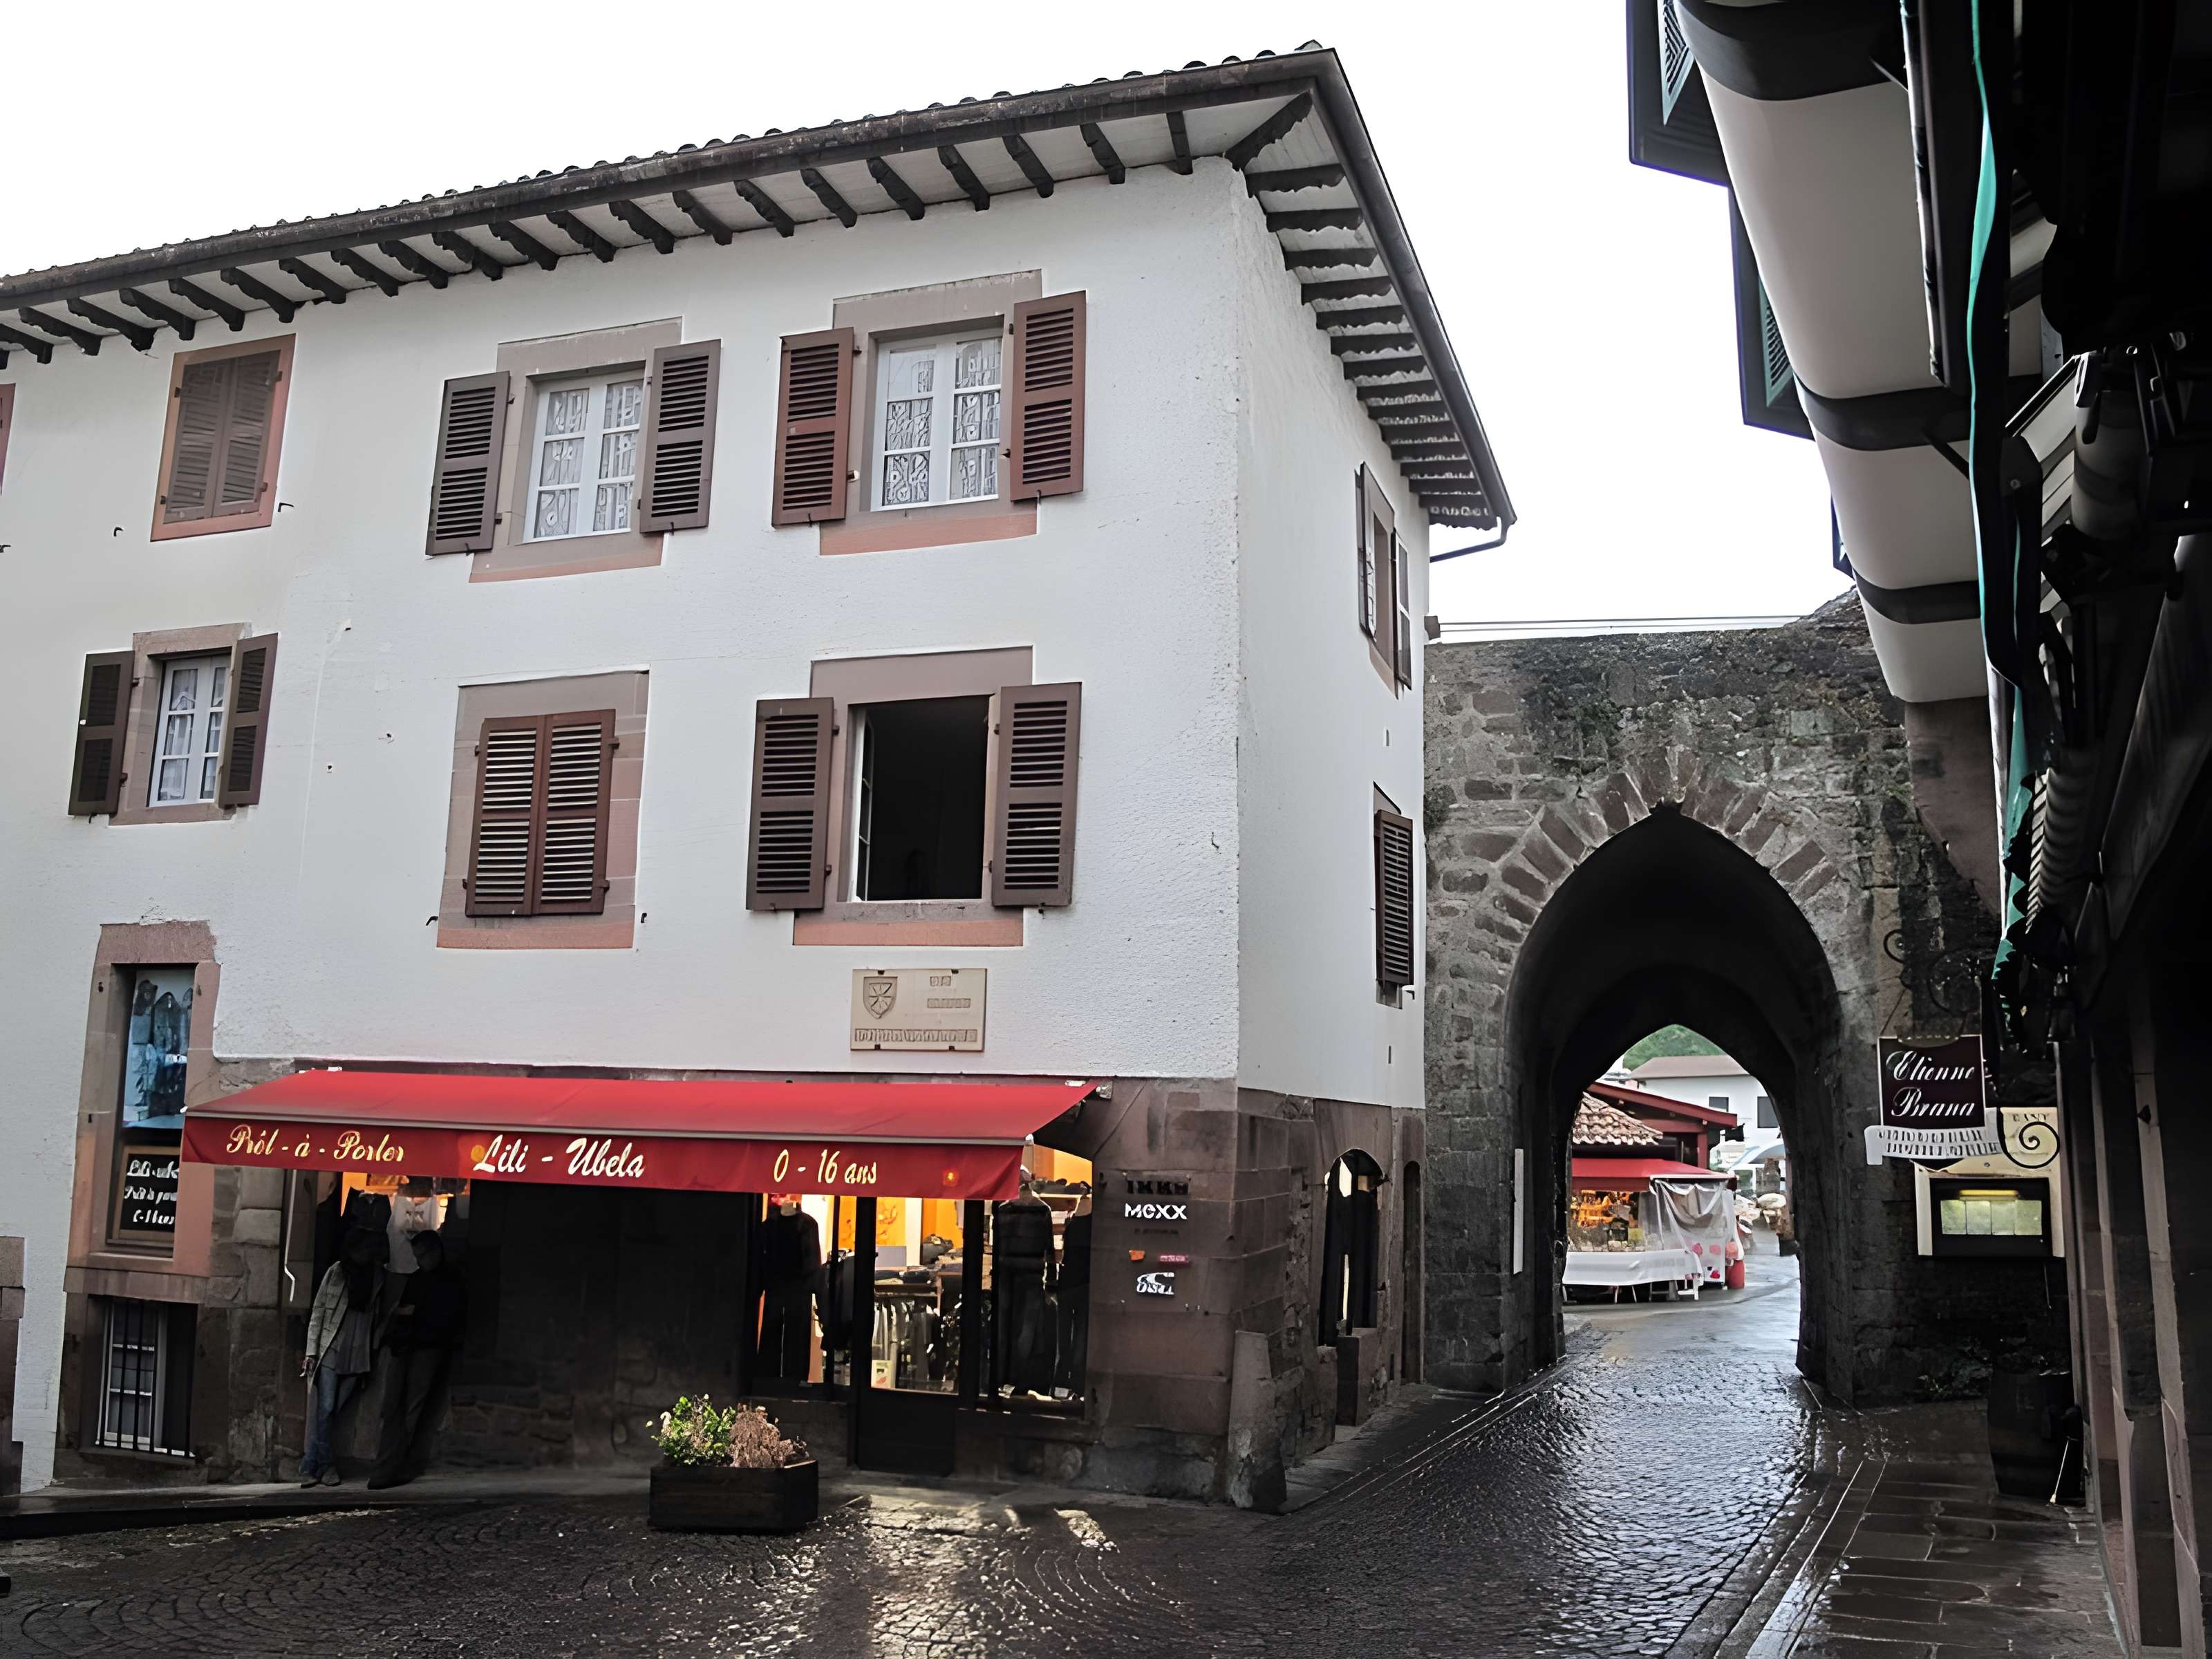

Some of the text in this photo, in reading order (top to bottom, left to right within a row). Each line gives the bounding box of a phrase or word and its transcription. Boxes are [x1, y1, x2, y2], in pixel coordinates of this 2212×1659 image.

[473, 1134, 529, 1173] Lili
[774, 1149, 789, 1182] 0
[818, 1149, 840, 1183] 16
